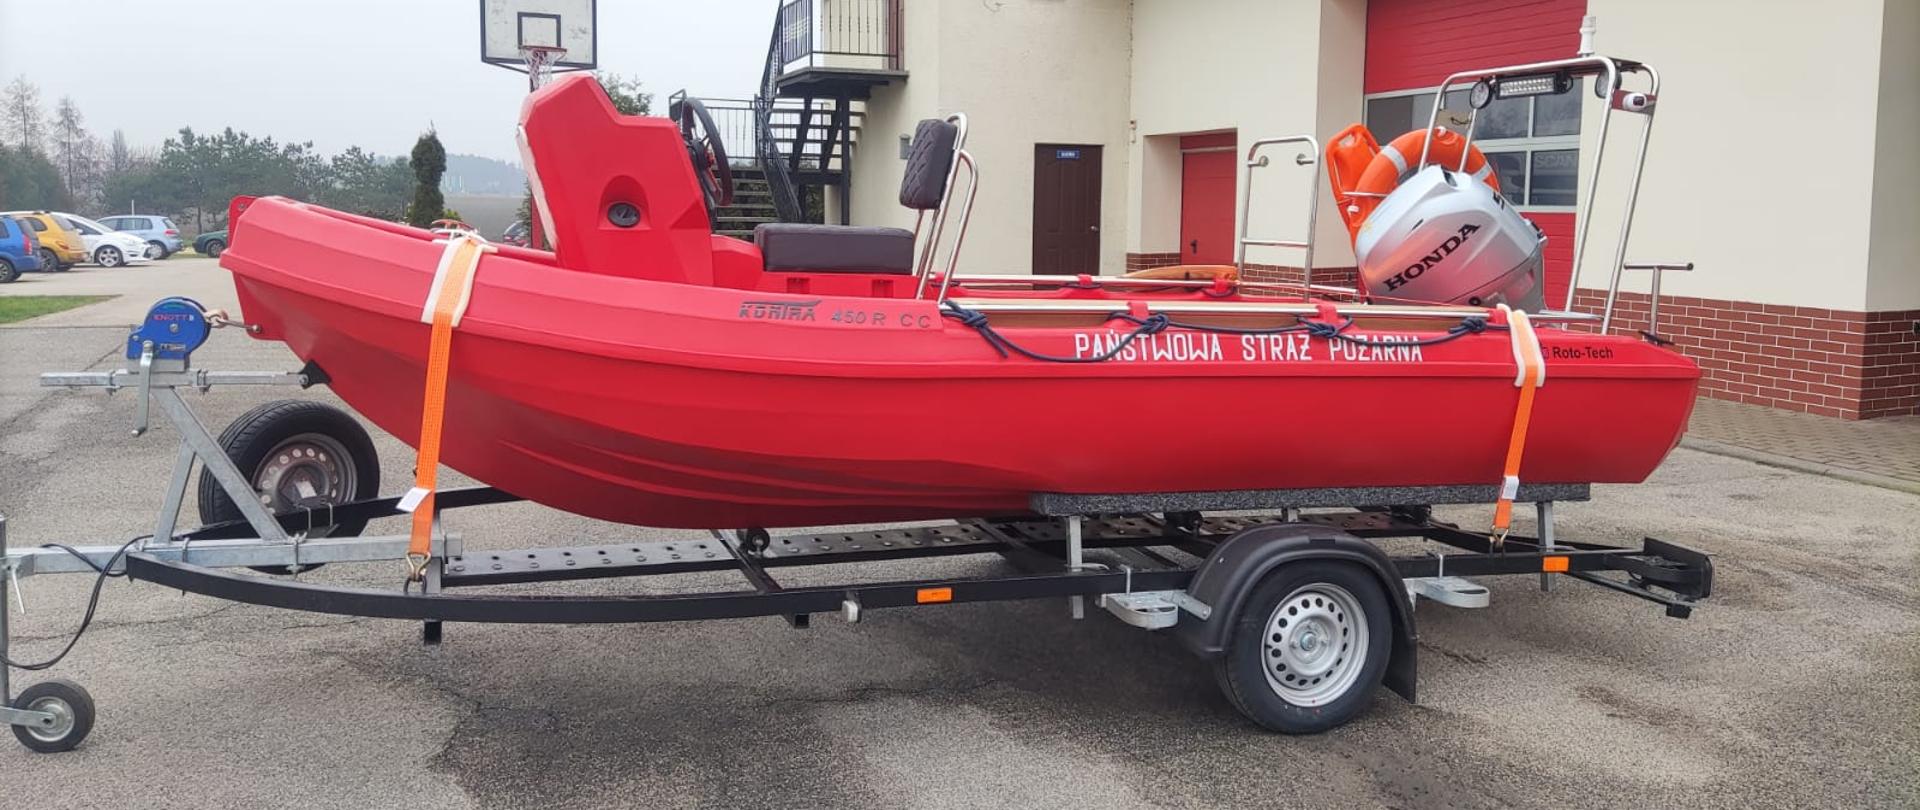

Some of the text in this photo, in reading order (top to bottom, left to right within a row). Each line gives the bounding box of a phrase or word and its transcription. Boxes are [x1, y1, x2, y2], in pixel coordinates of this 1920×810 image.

[1383, 221, 1481, 292] HONDA
[154, 313, 188, 321] KNOTT
[739, 299, 821, 321] KONTRA
[832, 310, 866, 324] 450
[1074, 329, 1223, 361] PAŃSTWOWA
[1552, 346, 1614, 359] Roto-Tech
